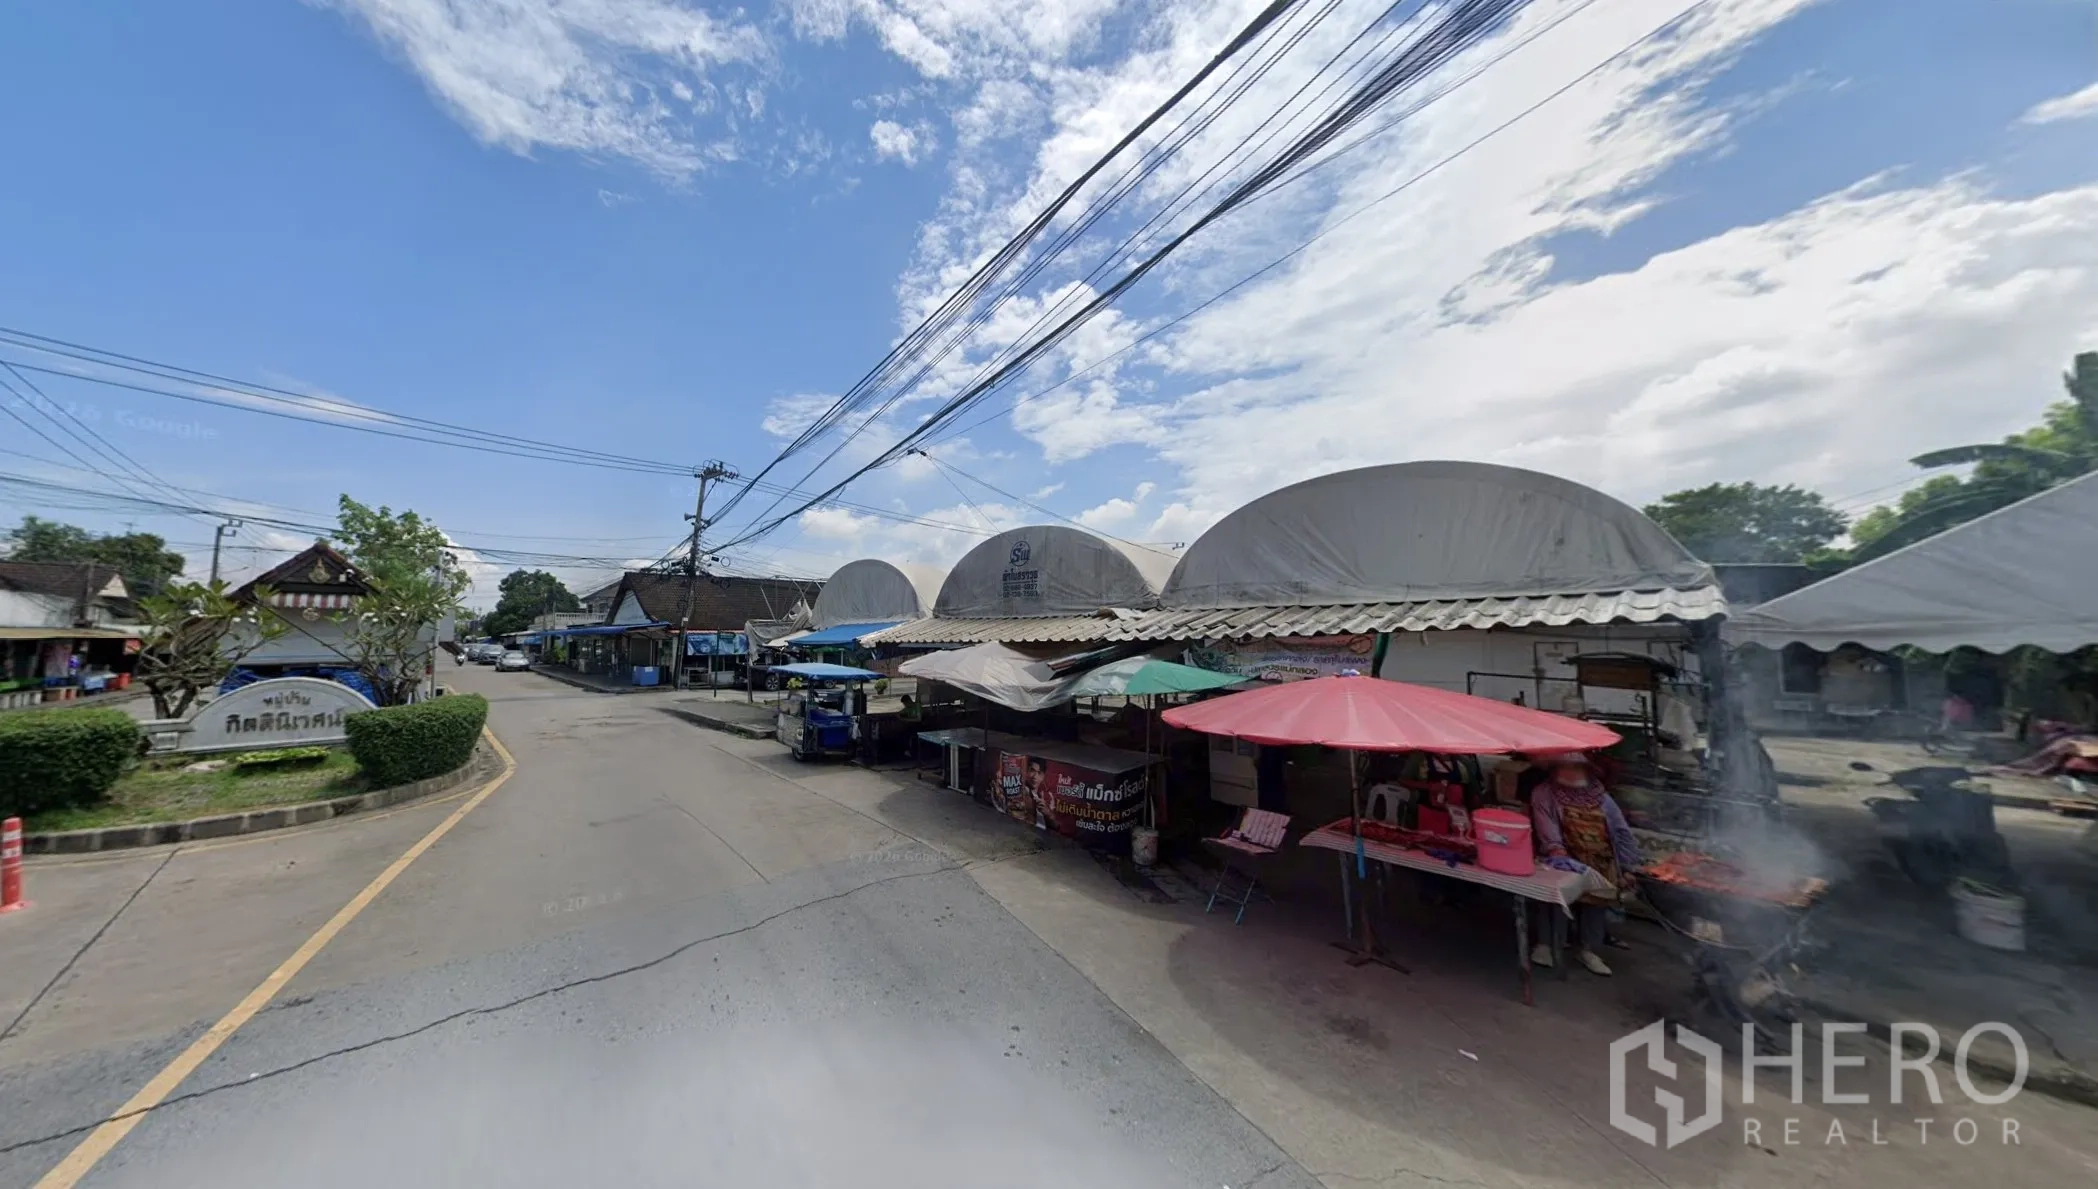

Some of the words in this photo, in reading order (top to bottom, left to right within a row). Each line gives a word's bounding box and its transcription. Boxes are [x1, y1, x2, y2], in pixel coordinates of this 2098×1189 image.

[1003, 774, 1022, 787] MAX
[1056, 799, 1120, 821] ไม่เติมน้ำตาล
